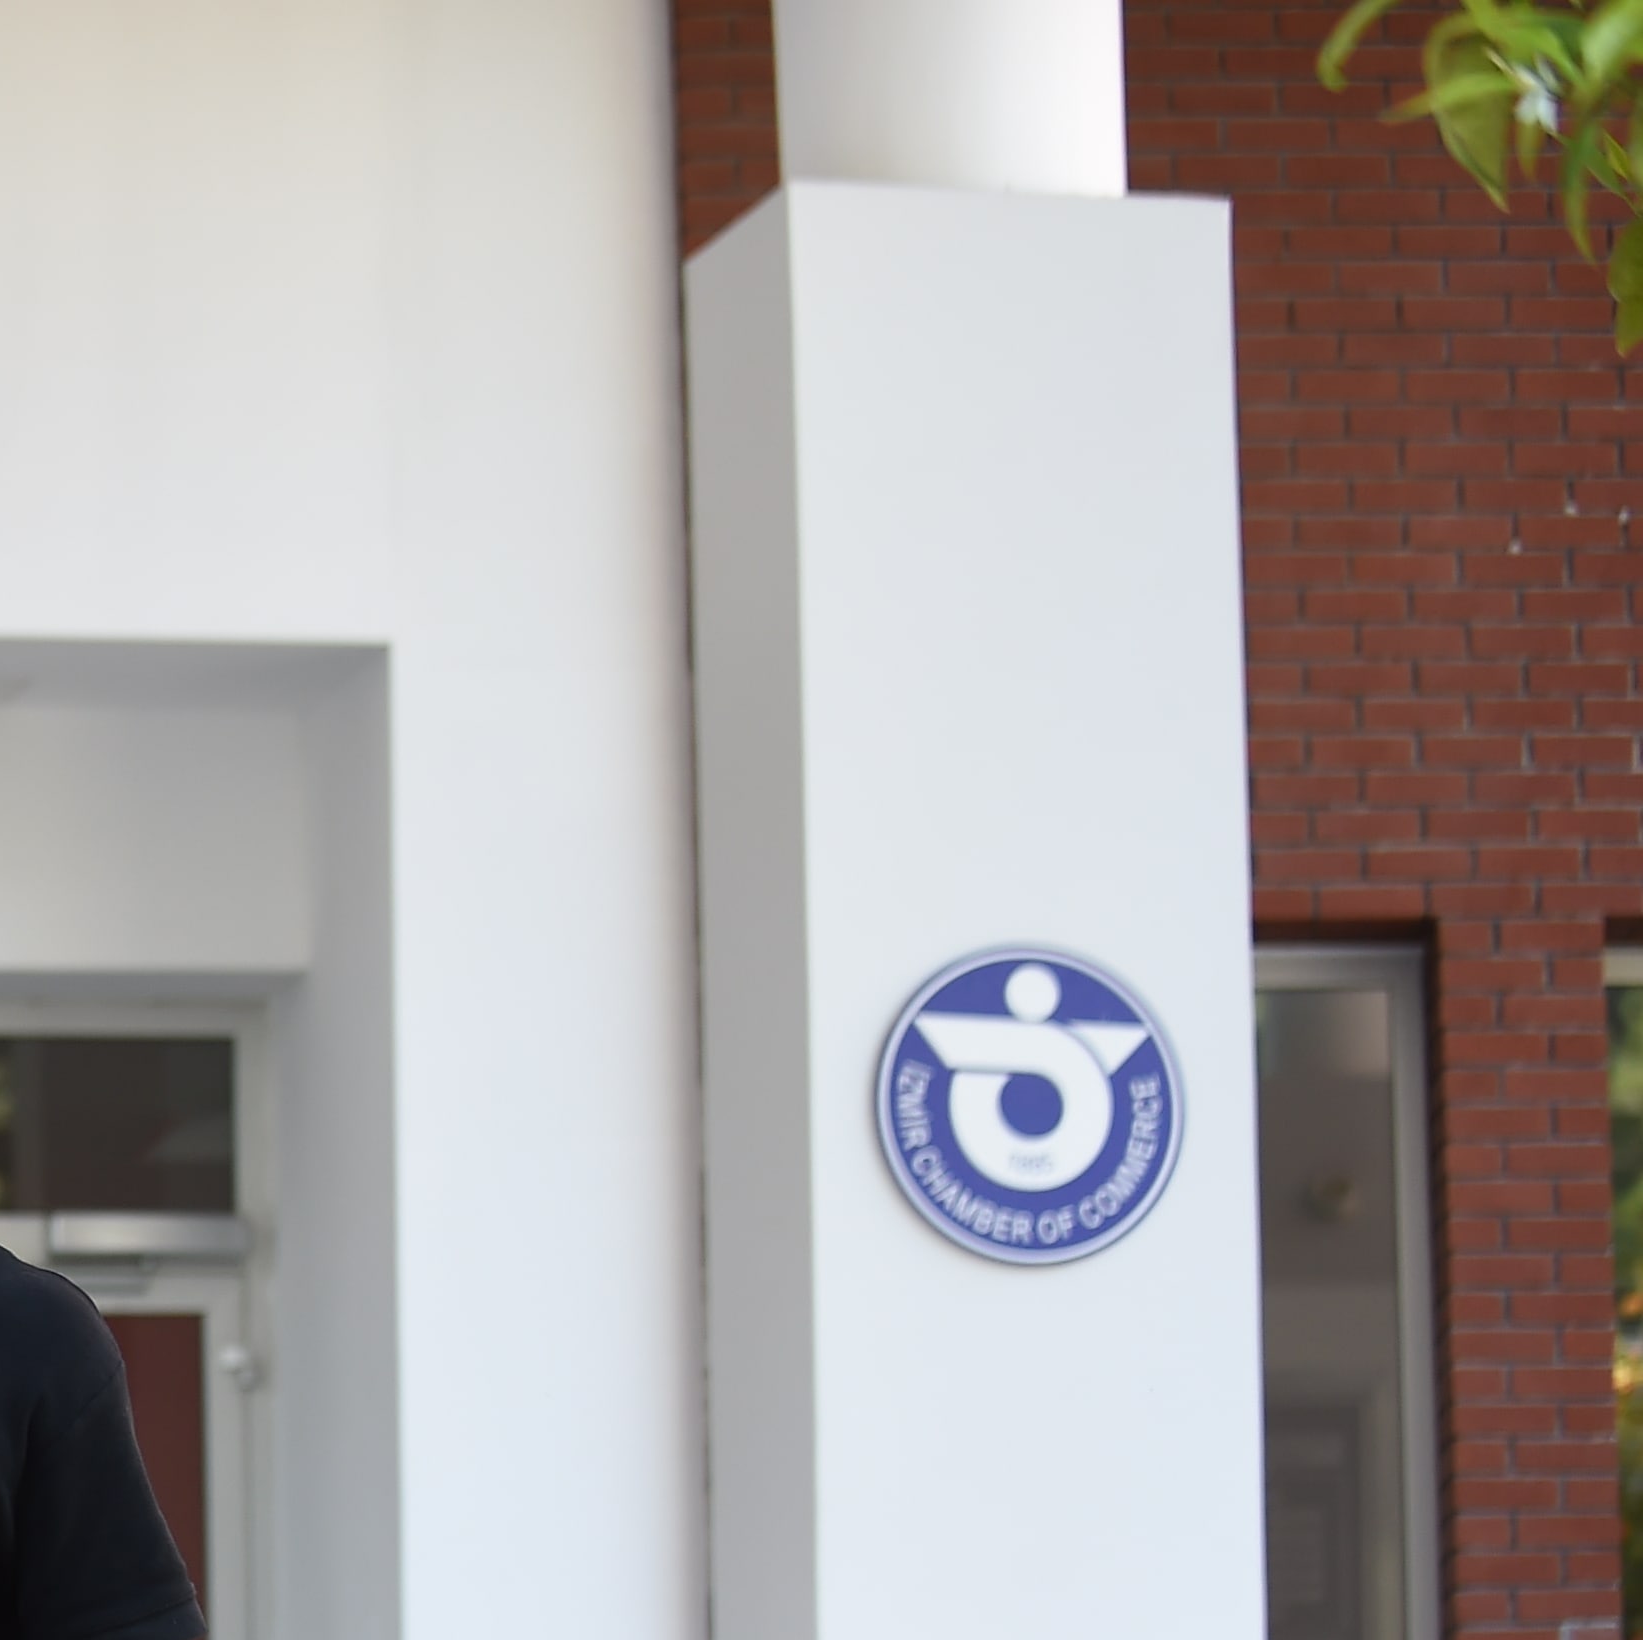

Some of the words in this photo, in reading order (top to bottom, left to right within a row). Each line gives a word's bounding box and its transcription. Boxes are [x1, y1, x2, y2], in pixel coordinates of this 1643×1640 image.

[911, 1145, 1035, 1244] CHAMBER
[1036, 1203, 1077, 1245] OF
[1078, 1073, 1162, 1230] COMMERCE
